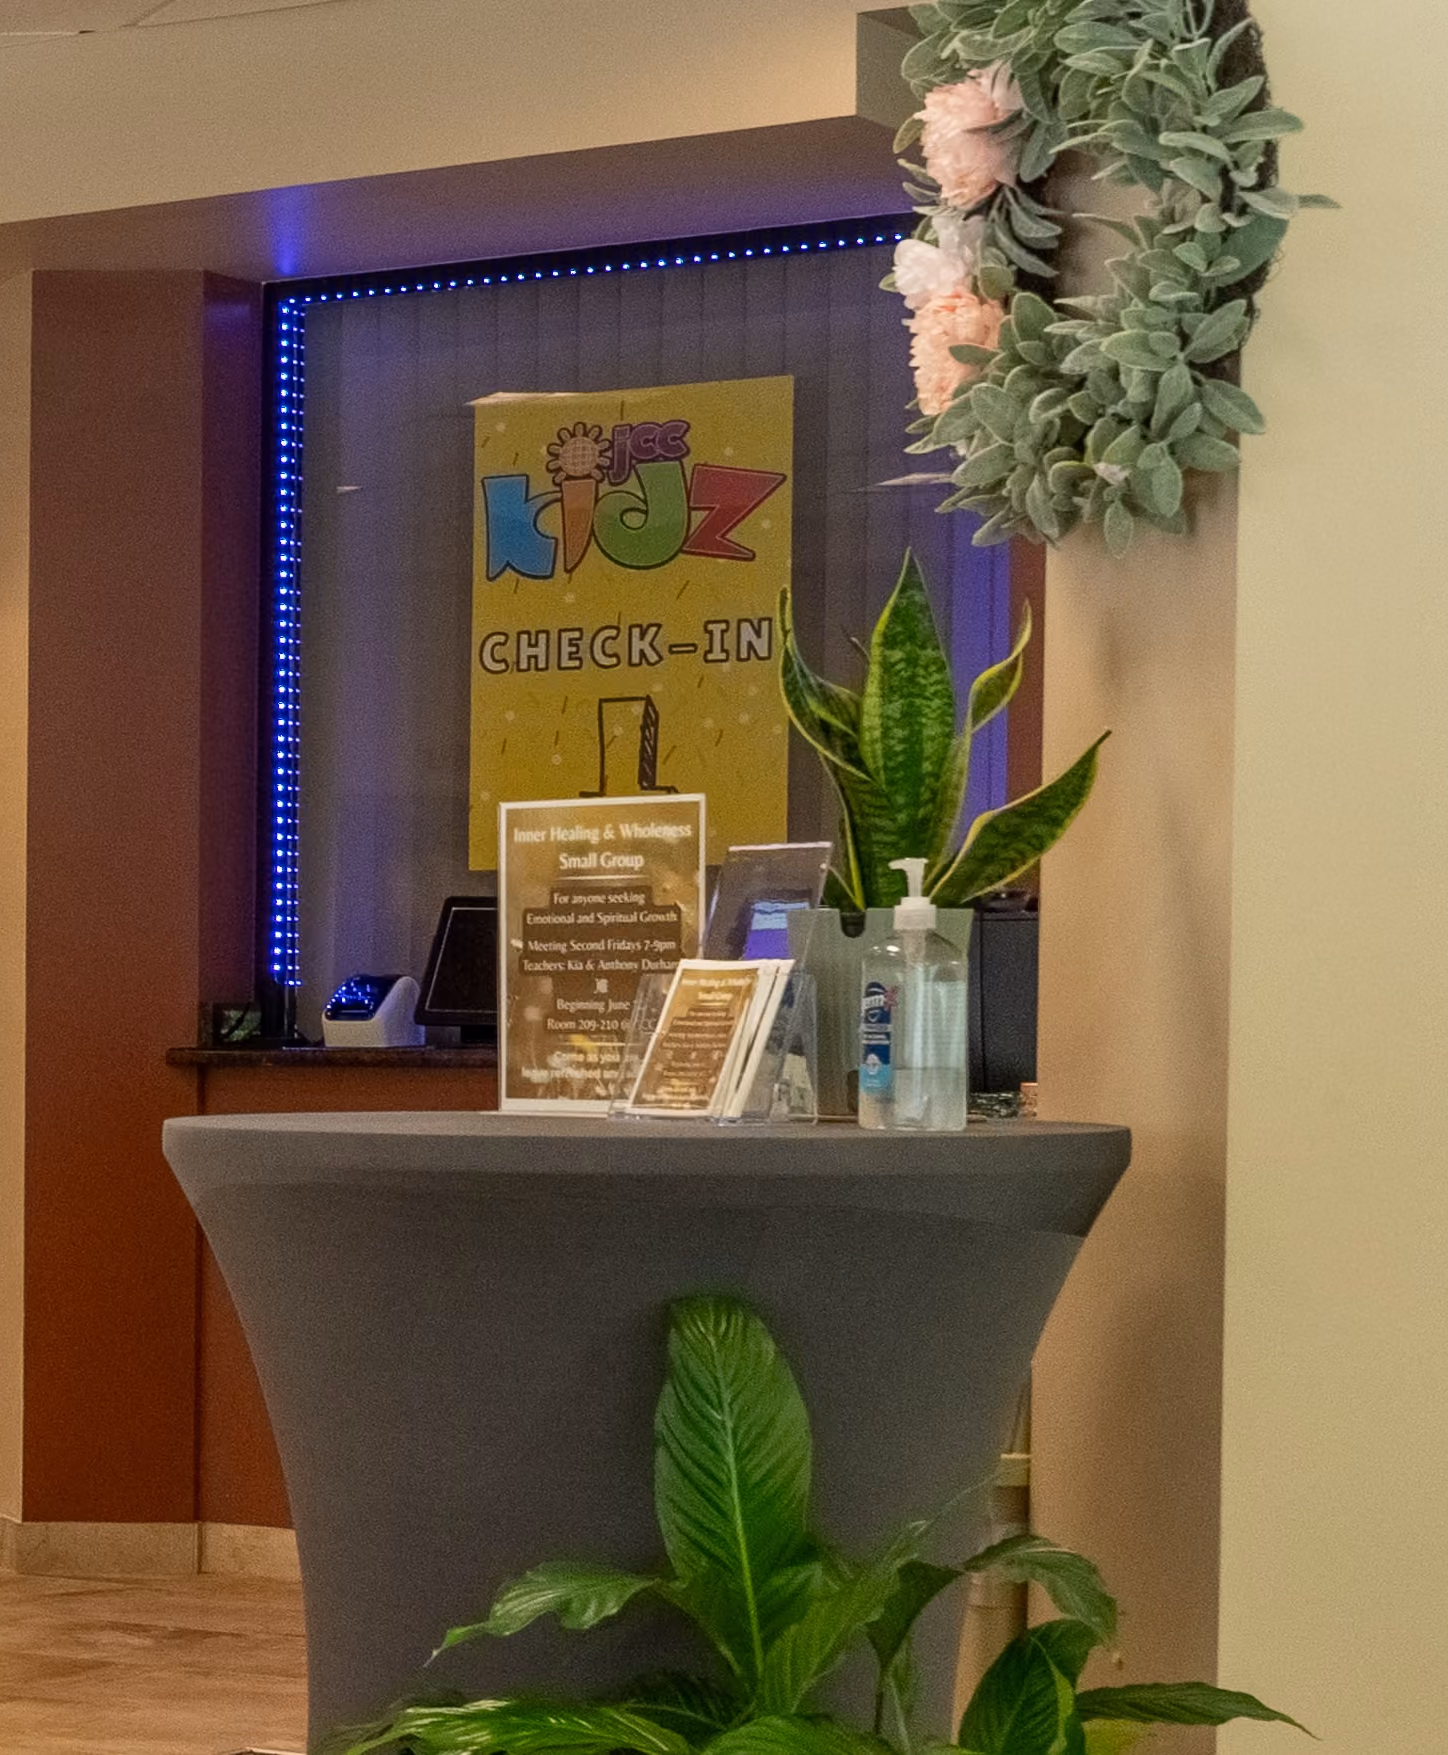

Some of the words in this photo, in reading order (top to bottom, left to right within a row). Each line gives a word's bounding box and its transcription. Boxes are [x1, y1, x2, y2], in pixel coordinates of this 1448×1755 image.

[480, 617, 774, 675] CHECK-IN
[513, 828, 547, 843] Inner
[549, 826, 600, 844] Healing
[603, 823, 615, 839] &
[619, 822, 692, 840] Wholeness
[559, 852, 597, 870] Small
[600, 851, 645, 871] Group
[553, 892, 570, 904] For
[572, 894, 606, 906] anyone
[607, 892, 646, 905] seeking
[526, 912, 574, 925] Emotional
[576, 912, 595, 924] and
[597, 911, 638, 926] Spiritual
[639, 910, 679, 923] Growth
[527, 940, 567, 954] Meeting
[569, 939, 605, 951] Second
[607, 939, 642, 952] Fridays
[643, 939, 677, 952] 7-9pm
[523, 960, 565, 971] Teachers:
[567, 959, 584, 971] Kia
[585, 960, 595, 971] &
[598, 959, 639, 973] Anthony
[556, 999, 605, 1013] Beginning
[607, 998, 631, 1014] June
[547, 1018, 576, 1030] Room
[579, 1018, 619, 1031] 209-210
